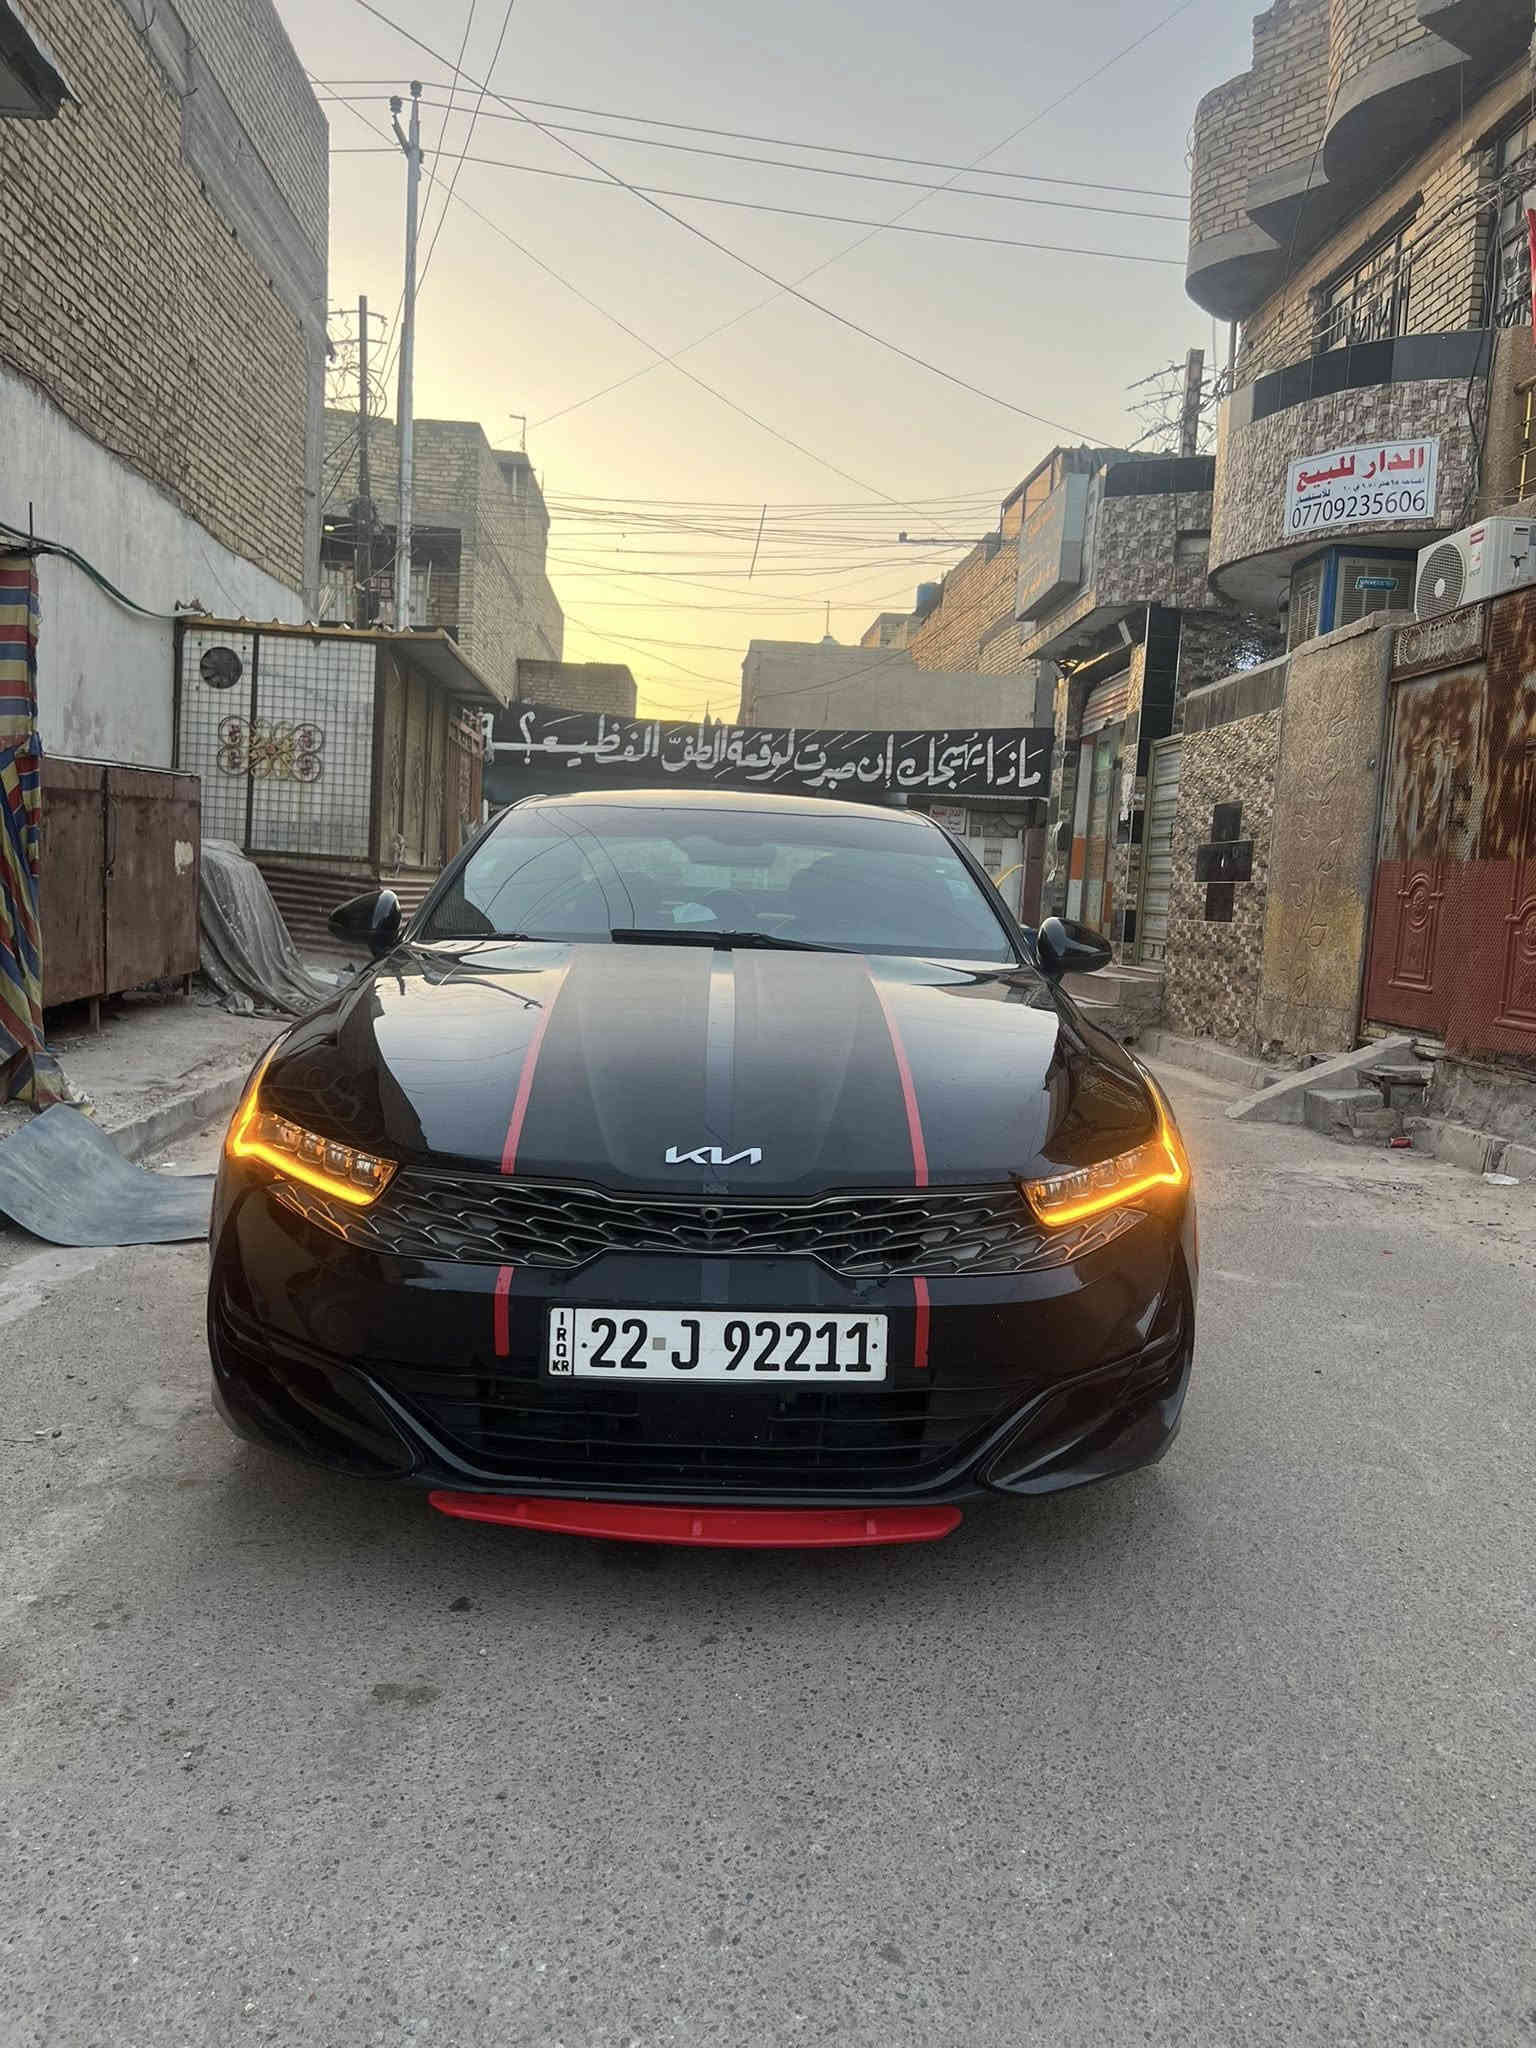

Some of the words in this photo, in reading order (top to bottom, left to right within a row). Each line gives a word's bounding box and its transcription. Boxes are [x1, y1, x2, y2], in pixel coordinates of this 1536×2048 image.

[1296, 454, 1356, 493] للبيع
[1361, 447, 1425, 479] الدار
[1291, 490, 1426, 529] 07709235606
[665, 1145, 762, 1165] KIA
[590, 1317, 649, 1370] 22
[671, 1319, 701, 1371] J
[723, 1320, 873, 1373] 92211
[552, 1359, 570, 1373] KR
